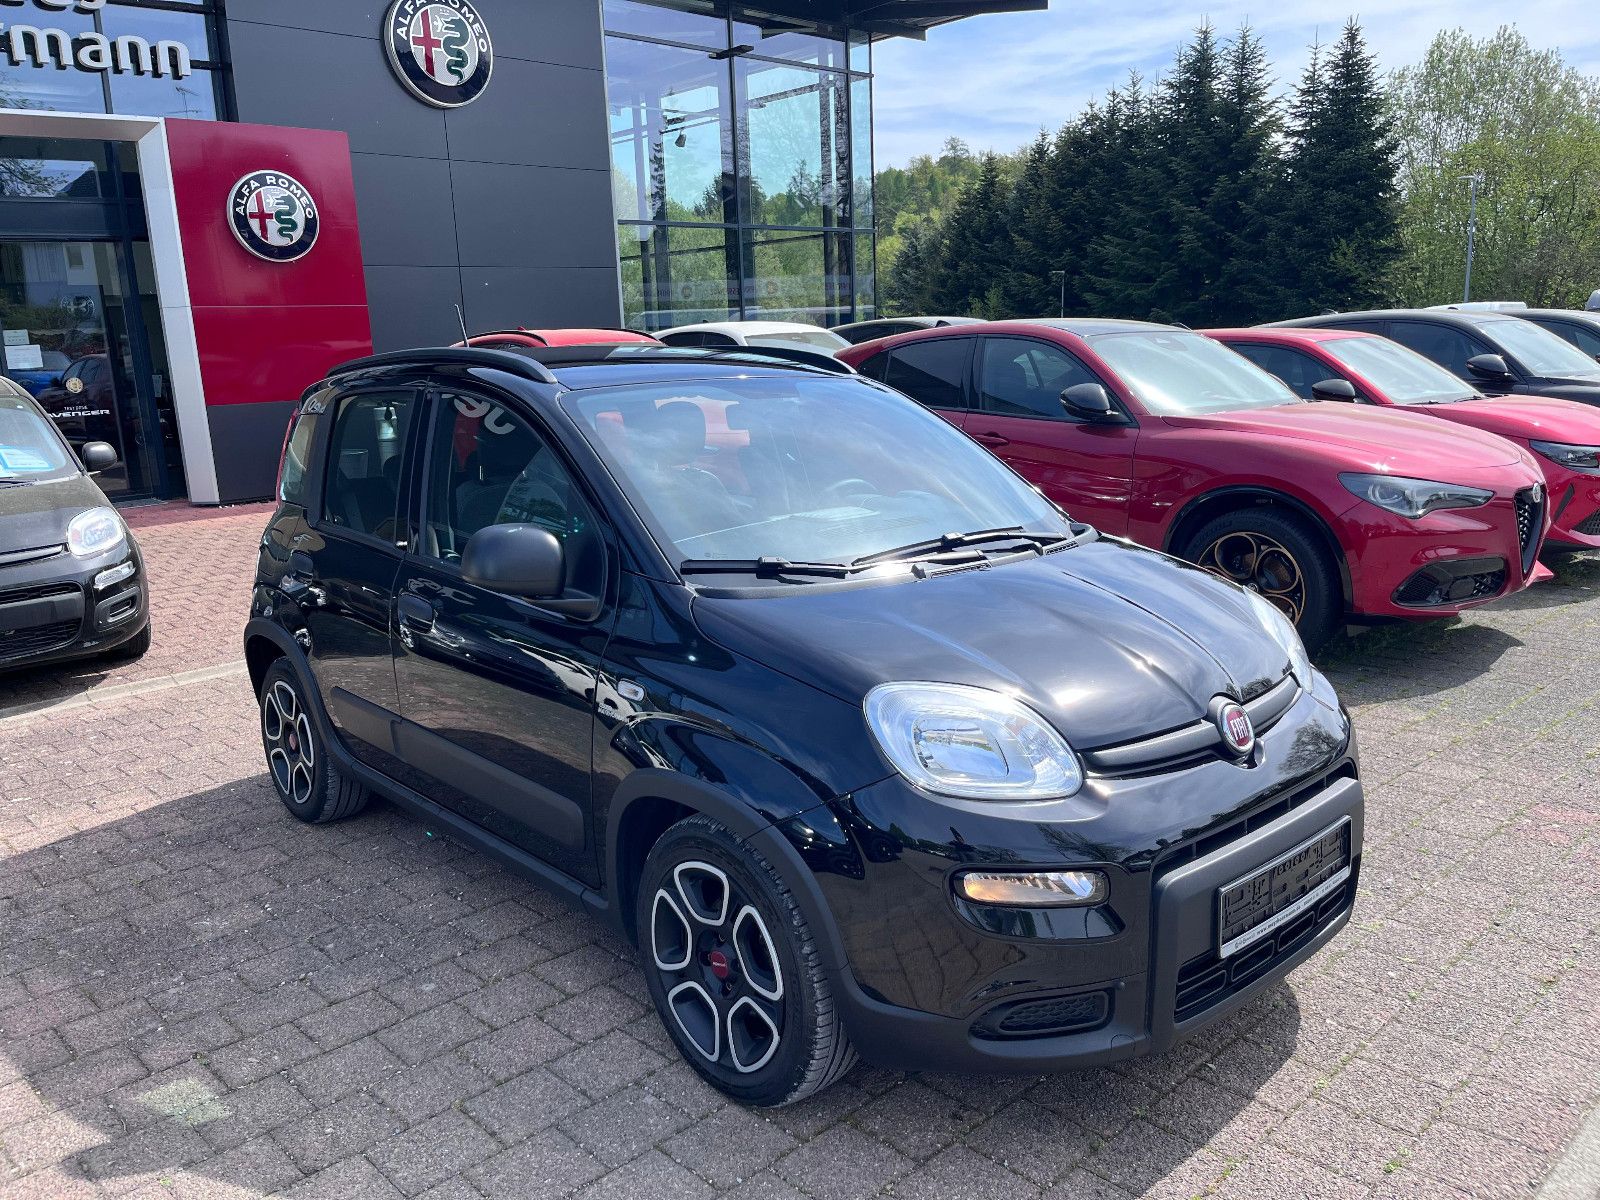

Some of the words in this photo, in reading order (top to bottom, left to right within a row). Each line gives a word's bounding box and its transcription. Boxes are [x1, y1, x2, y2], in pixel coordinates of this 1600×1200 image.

[0, 23, 191, 76] mann
[436, 0, 487, 52] OMEO
[236, 180, 260, 216] ALFA
[265, 175, 314, 219] ROMEO
